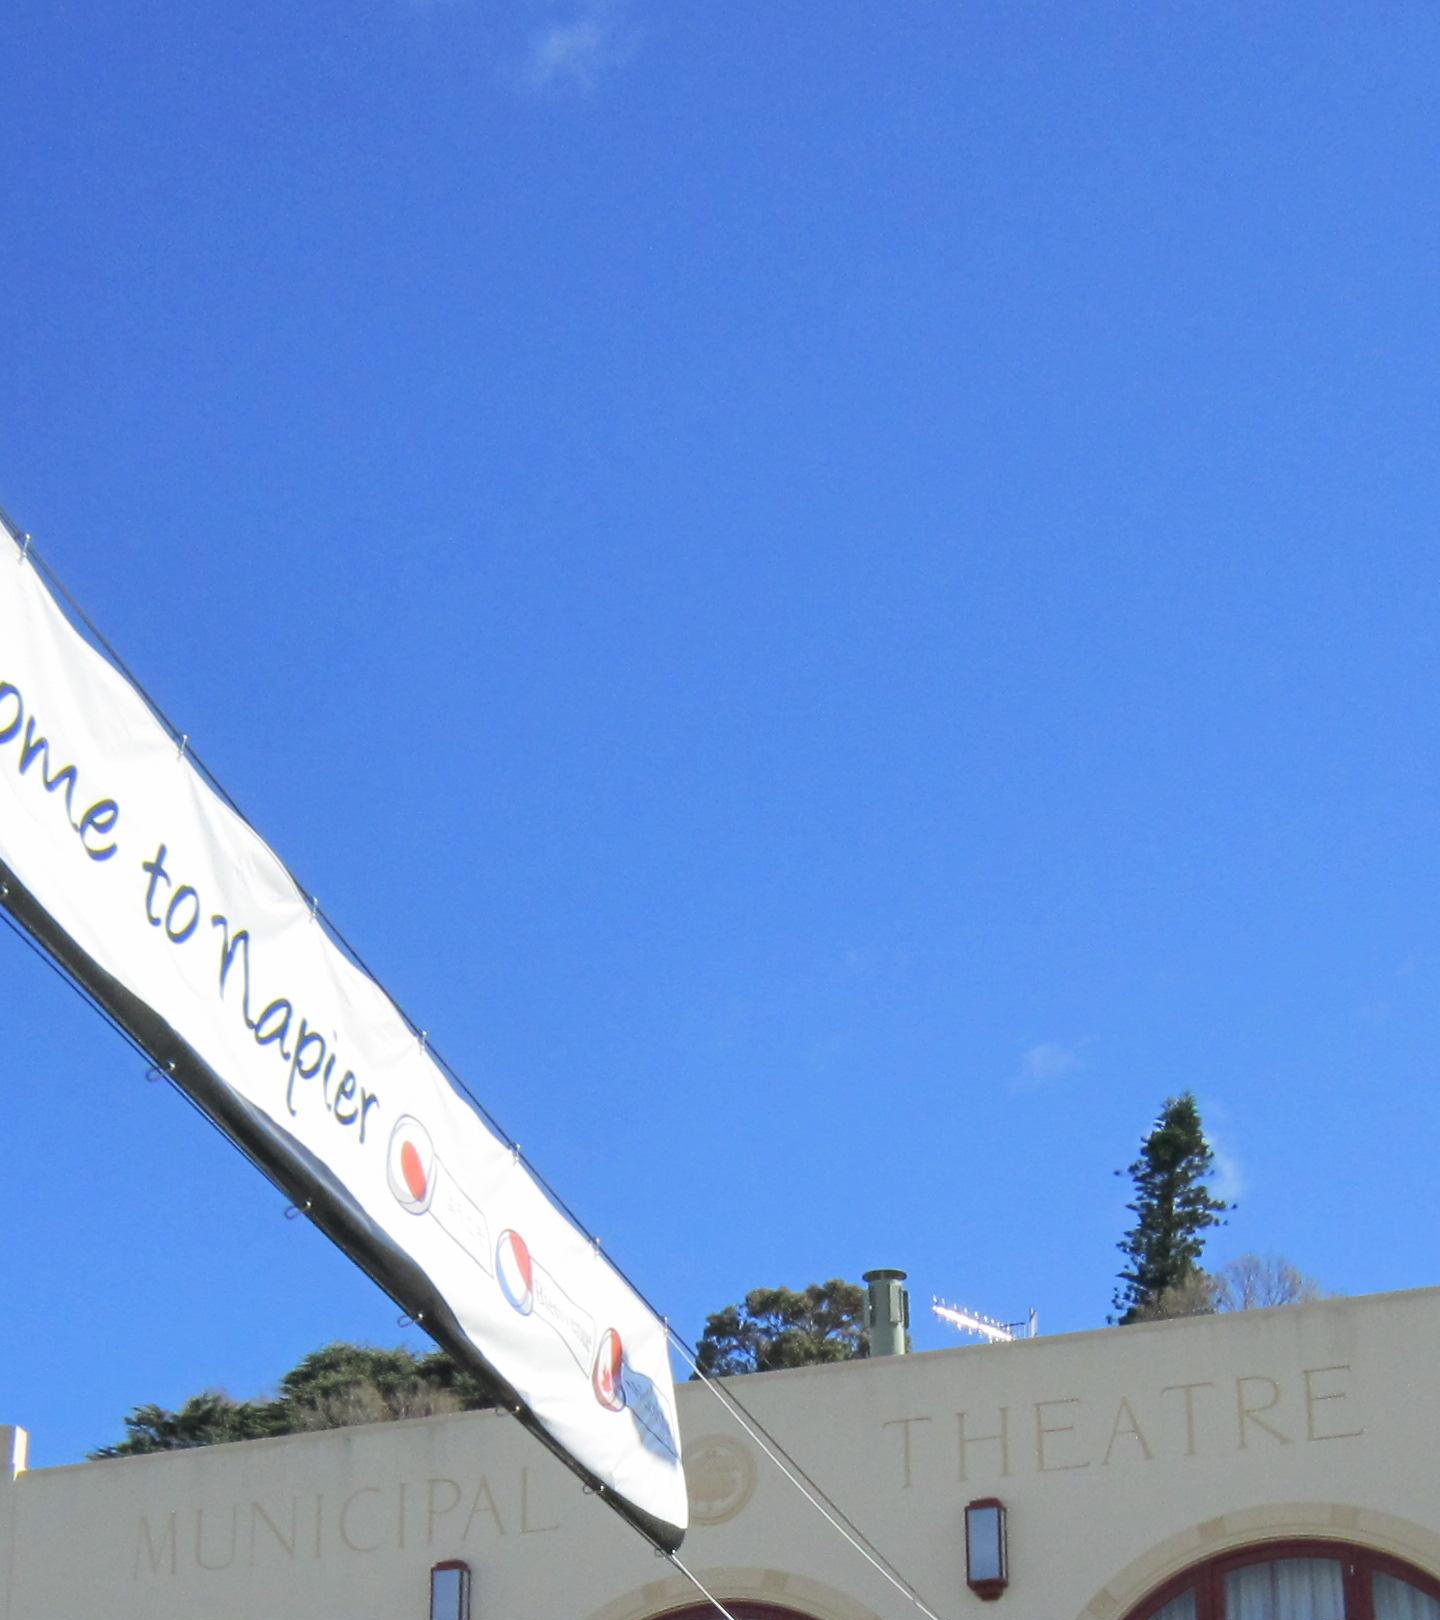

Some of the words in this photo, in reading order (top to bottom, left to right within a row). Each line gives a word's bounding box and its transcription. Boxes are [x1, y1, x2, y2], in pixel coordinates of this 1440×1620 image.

[142, 844, 200, 944] to
[212, 914, 381, 1144] Napier
[133, 1466, 561, 1580] MUNICIPAL
[883, 1364, 1365, 1489] THEATRE
